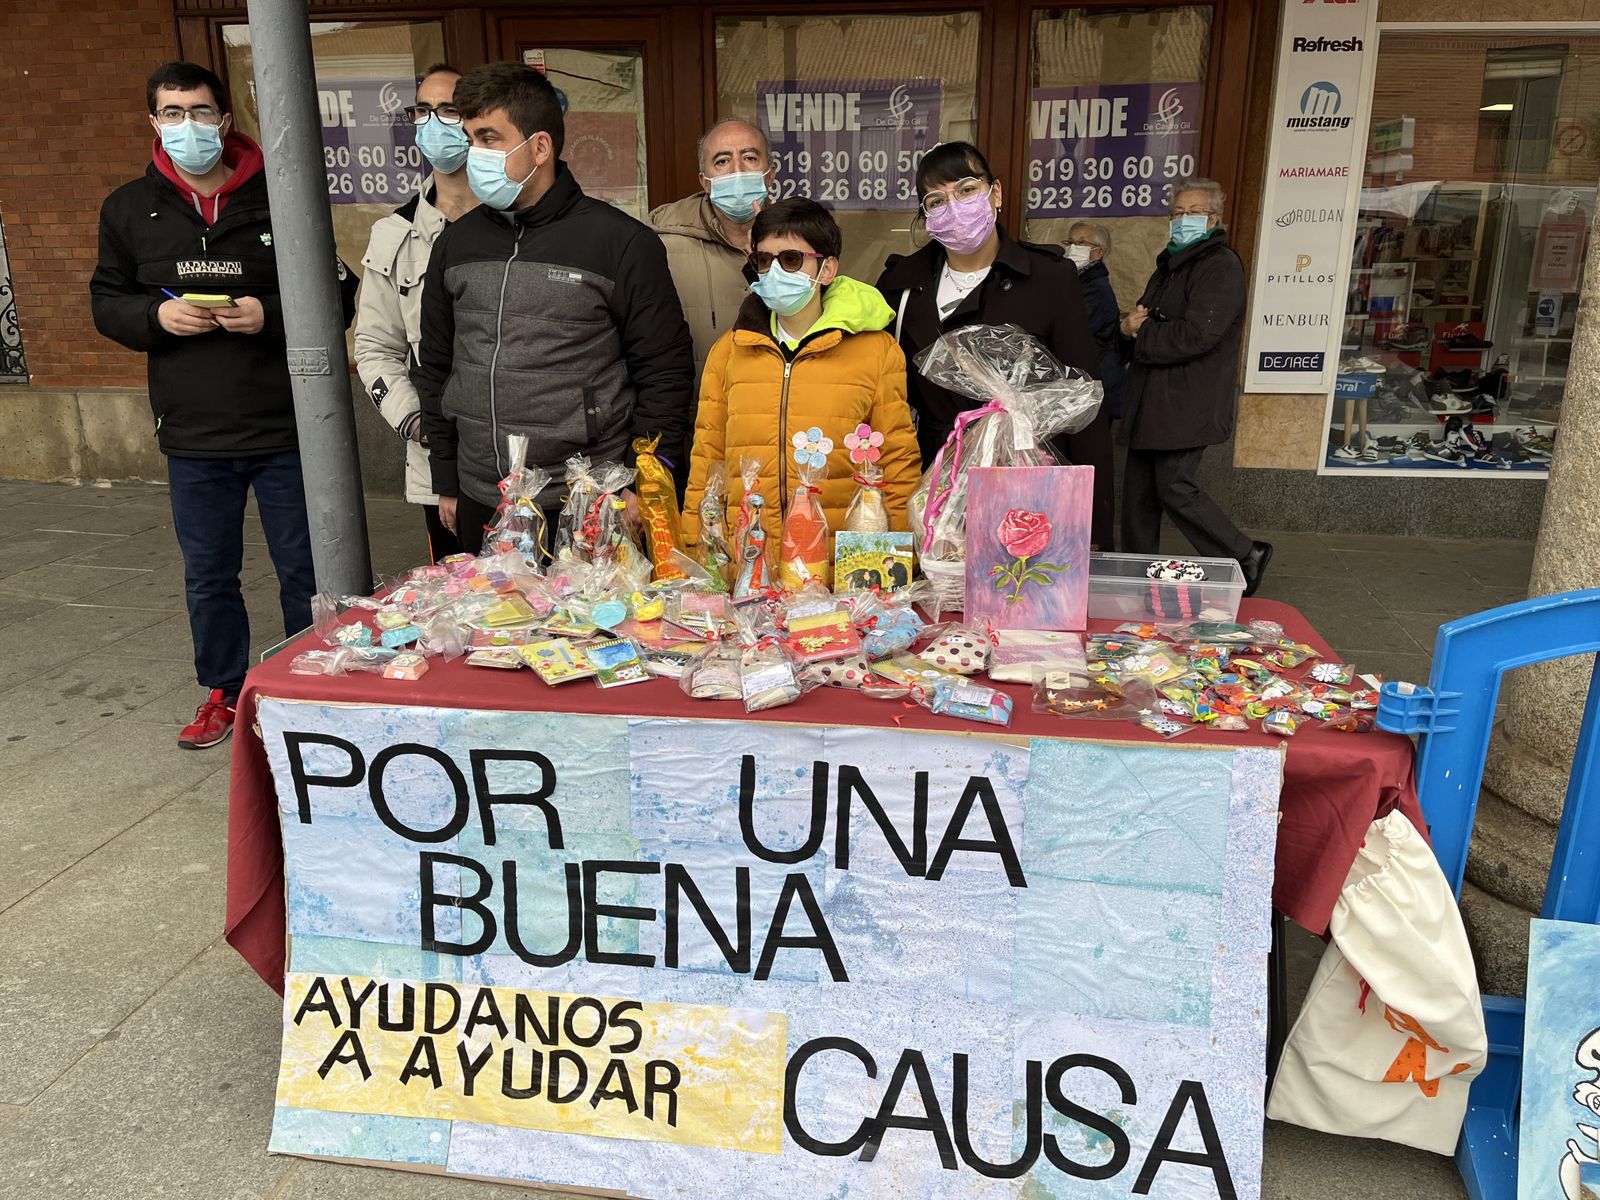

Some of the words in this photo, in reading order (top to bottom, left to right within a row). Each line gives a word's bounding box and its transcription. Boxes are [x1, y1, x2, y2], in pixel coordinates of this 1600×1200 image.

[1293, 37, 1363, 52] Refresh
[765, 92, 861, 131] VENDE
[1031, 97, 1129, 139] VENDE
[1286, 116, 1351, 129] mustang
[1181, 121, 1191, 129] Gil
[324, 146, 350, 168] 30
[358, 146, 386, 168] 60
[394, 146, 421, 168] 50
[771, 151, 812, 173] 619
[820, 151, 849, 173] 30
[858, 151, 888, 173] 60
[1029, 158, 1075, 182] 619
[1083, 157, 1114, 181] 30
[1123, 155, 1154, 179] 60
[1163, 154, 1195, 178] 50
[326, 173, 354, 194] 26
[361, 173, 389, 194] 68
[396, 172, 421, 194] 34
[1279, 167, 1349, 178] MARIAMARE
[768, 178, 812, 200] 923
[820, 178, 850, 200] 26
[858, 178, 888, 200] 68
[1027, 186, 1073, 209] 923
[1081, 185, 1113, 208] 26
[1121, 184, 1152, 208] 68
[1296, 209, 1344, 222] ROLDAN
[1268, 275, 1334, 283] PITILLOS
[1262, 314, 1329, 326] MENBUR
[1264, 354, 1320, 369] DESIREÉ
[283, 731, 565, 850] POR
[739, 755, 1028, 888] UNA
[419, 851, 849, 982] BUENA
[294, 976, 644, 1054] AYUDANOS
[317, 1031, 373, 1082] A
[400, 1036, 681, 1128] AYUDAR
[783, 1036, 1238, 1200] CAUSA
